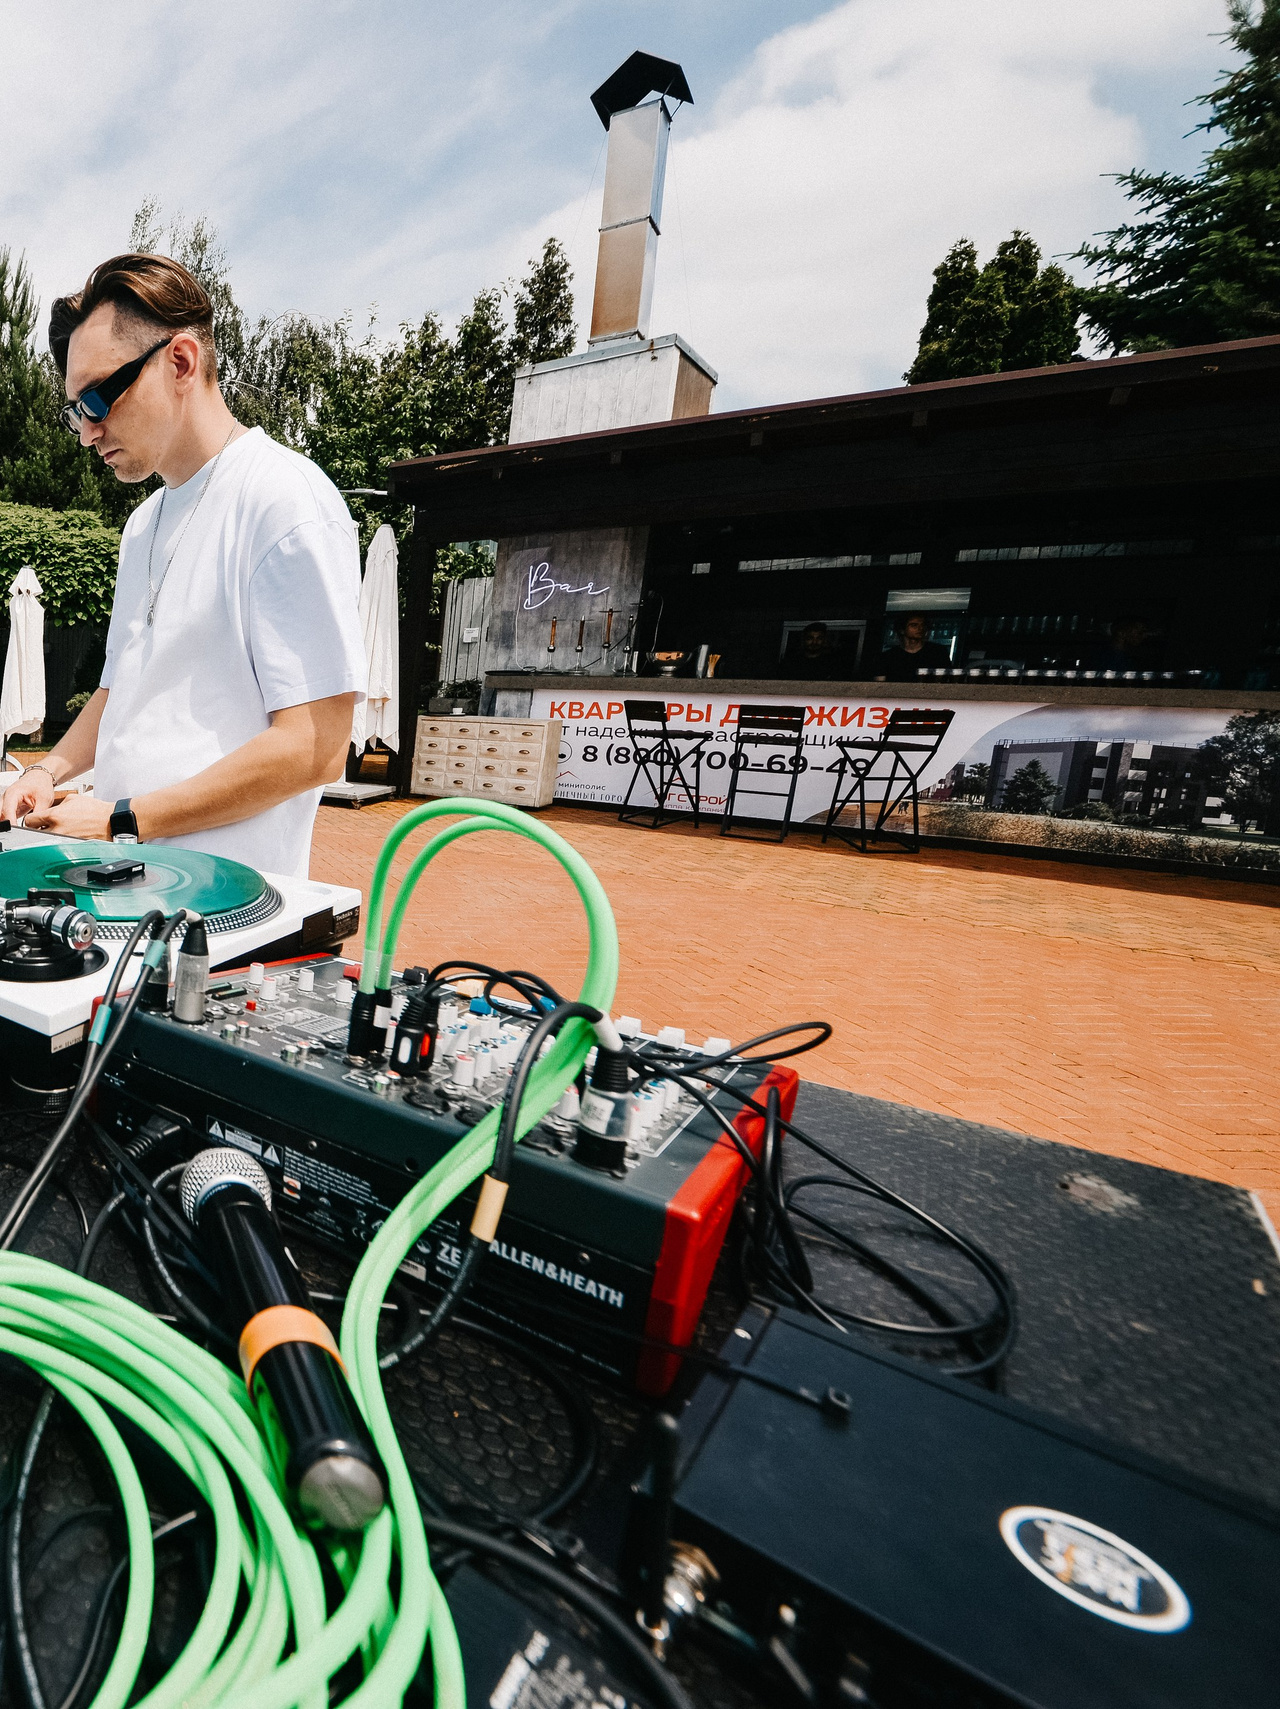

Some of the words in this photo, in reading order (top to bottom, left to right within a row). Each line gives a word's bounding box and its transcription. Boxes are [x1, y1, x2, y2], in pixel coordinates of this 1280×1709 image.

[523, 562, 611, 610] Bar
[549, 701, 713, 723] КВАРРЫ
[582, 745, 598, 762] 8
[690, 751, 871, 778] 700-69-49
[600, 793, 624, 803] ГОРО
[488, 1238, 625, 1309] ALLEN&HEATH
